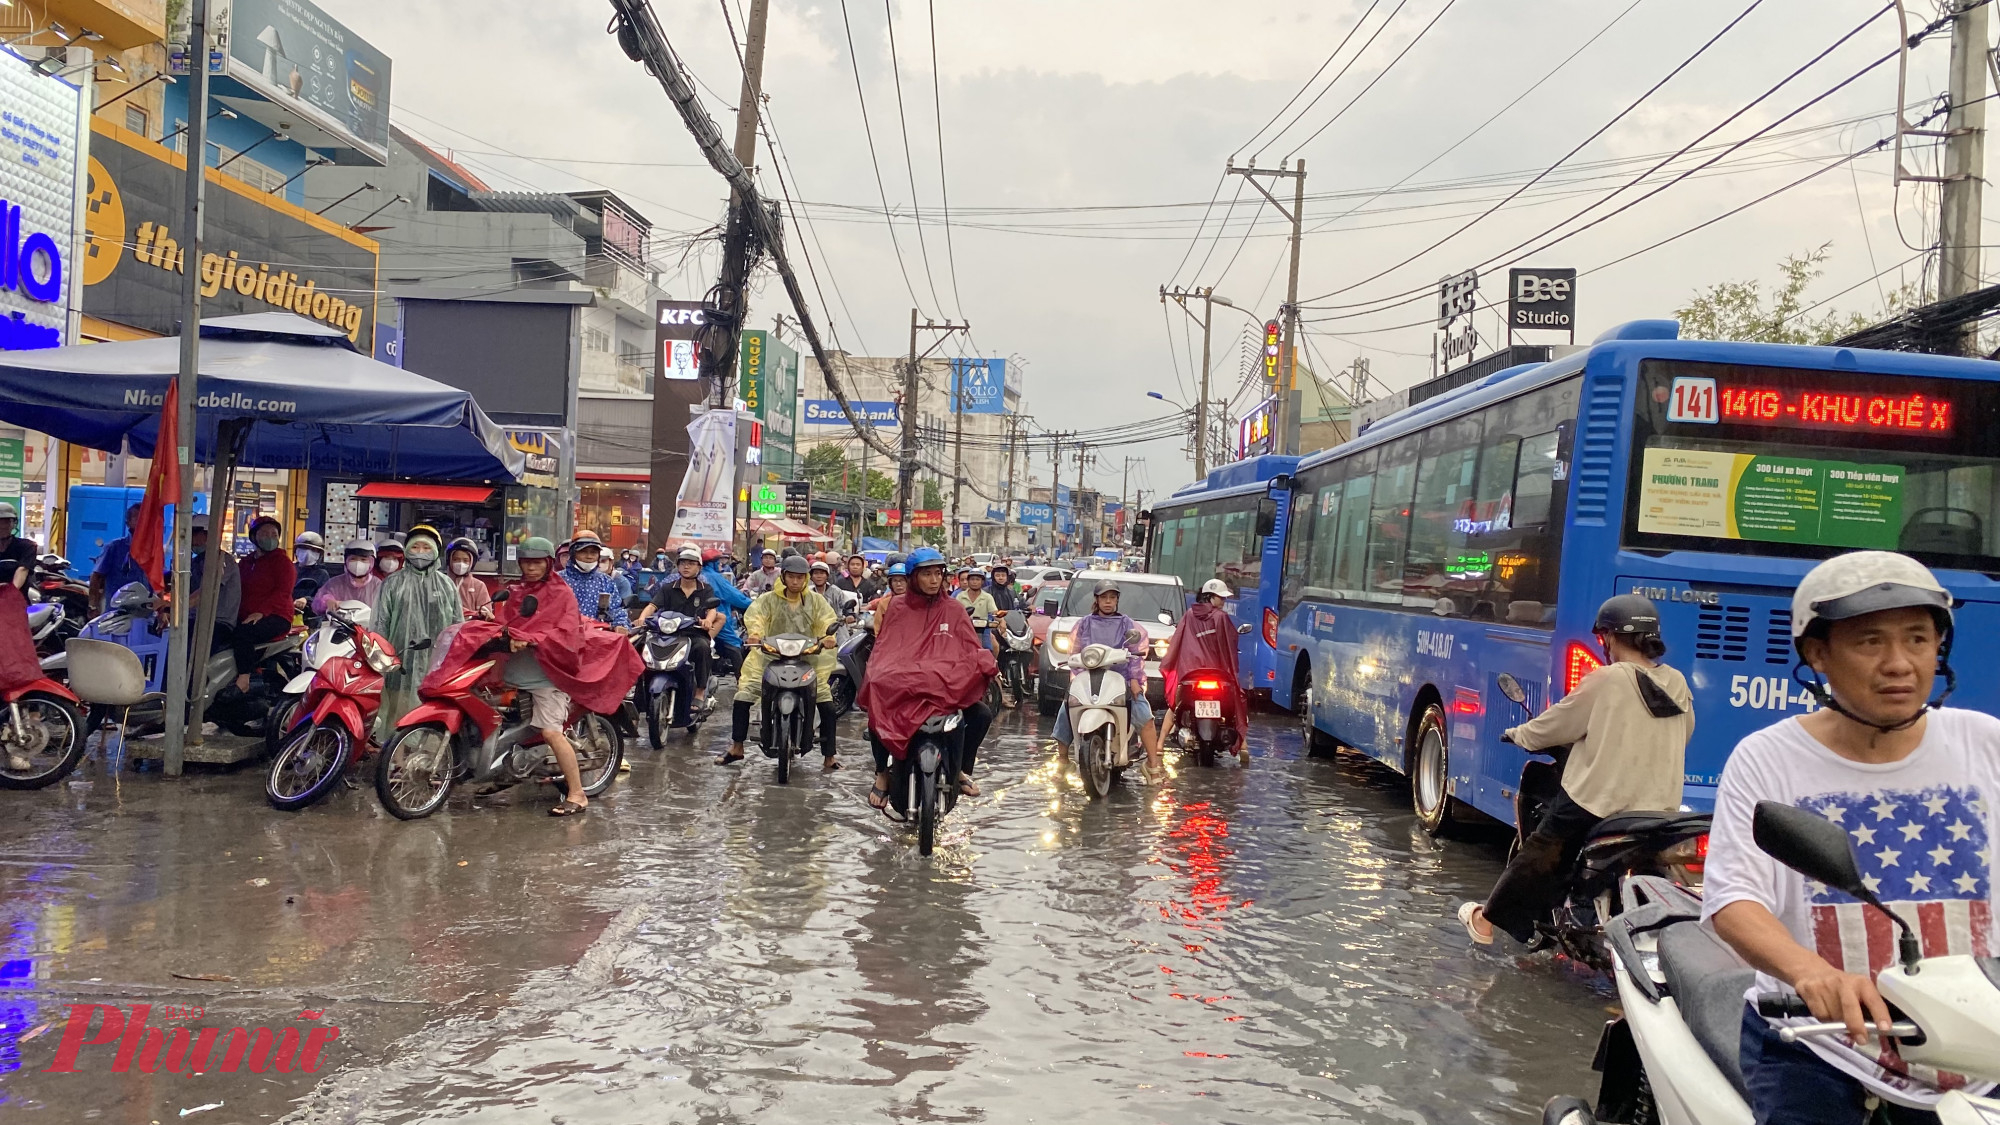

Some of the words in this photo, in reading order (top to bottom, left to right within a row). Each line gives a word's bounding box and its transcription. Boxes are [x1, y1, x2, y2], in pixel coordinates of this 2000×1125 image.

[1517, 274, 1570, 303] Bee
[660, 308, 704, 325] KFC
[1516, 309, 1570, 325] Studio
[1675, 384, 1712, 419] 141
[1722, 388, 1779, 418] 141G
[1801, 393, 1861, 424] KHU
[1756, 463, 1771, 473] 300
[1830, 469, 1845, 479] 300
[758, 485, 777, 501] Ốc
[751, 500, 785, 515] Ngon
[1023, 505, 1050, 520] Diag
[685, 522, 697, 531] 24
[713, 541, 726, 553] 14
[1632, 586, 1667, 600] KIM
[1671, 587, 1720, 604] LONG
[1416, 629, 1455, 660] 50H-418.07
